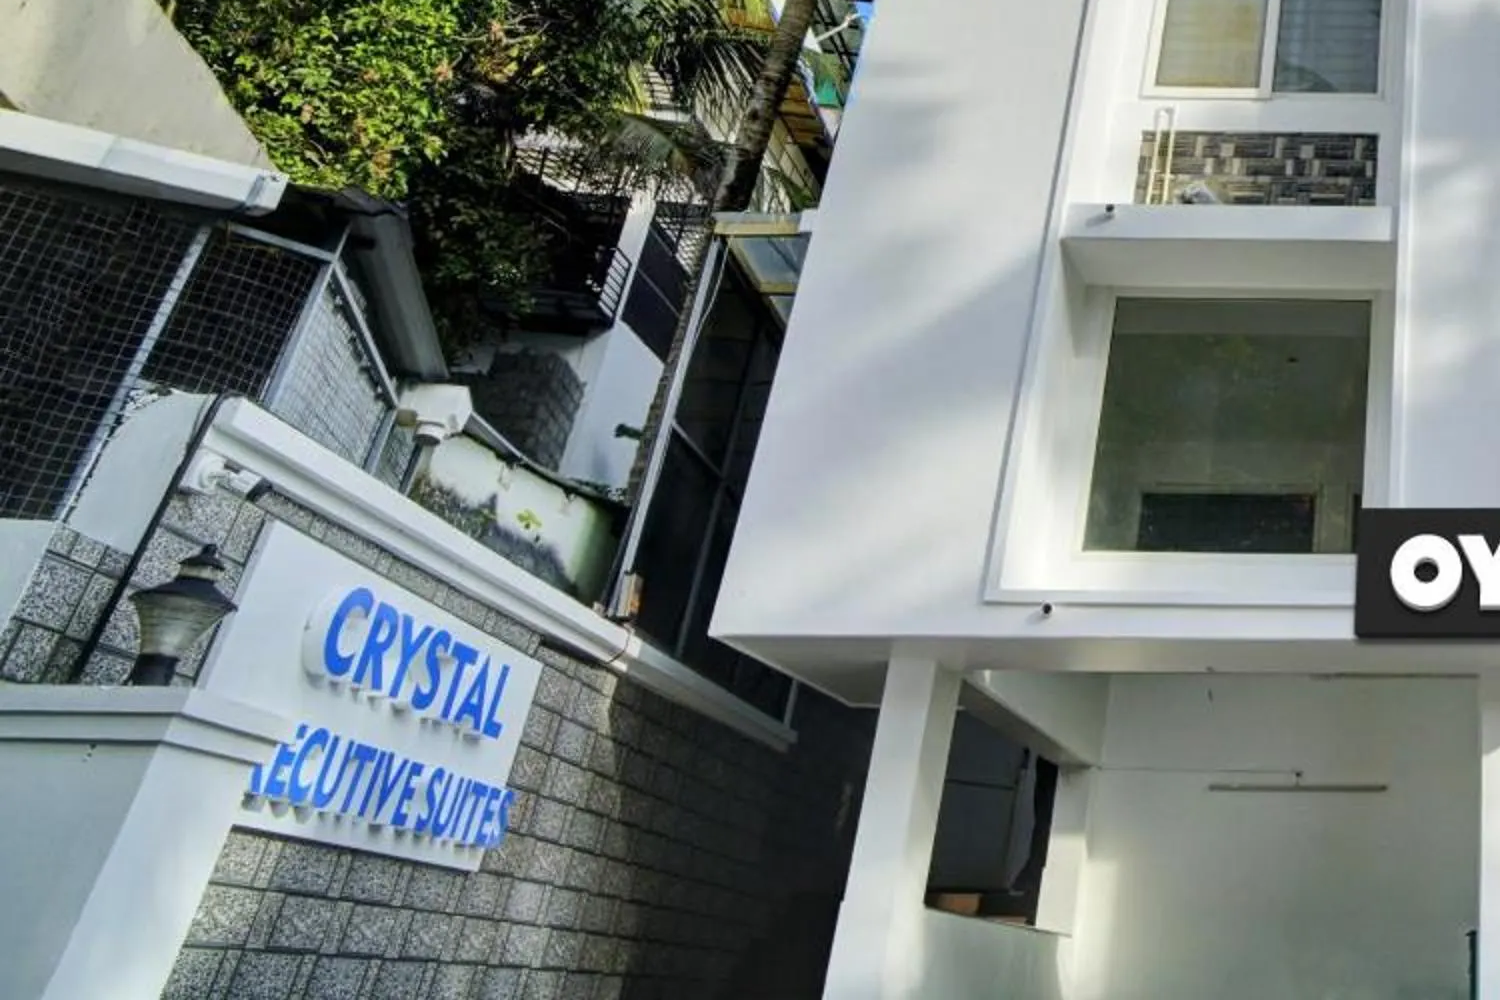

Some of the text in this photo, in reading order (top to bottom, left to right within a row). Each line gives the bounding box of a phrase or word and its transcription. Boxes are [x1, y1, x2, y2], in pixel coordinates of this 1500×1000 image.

[323, 586, 511, 740] CRYSTAL
[249, 723, 516, 849] ECUTIVE SUITES
